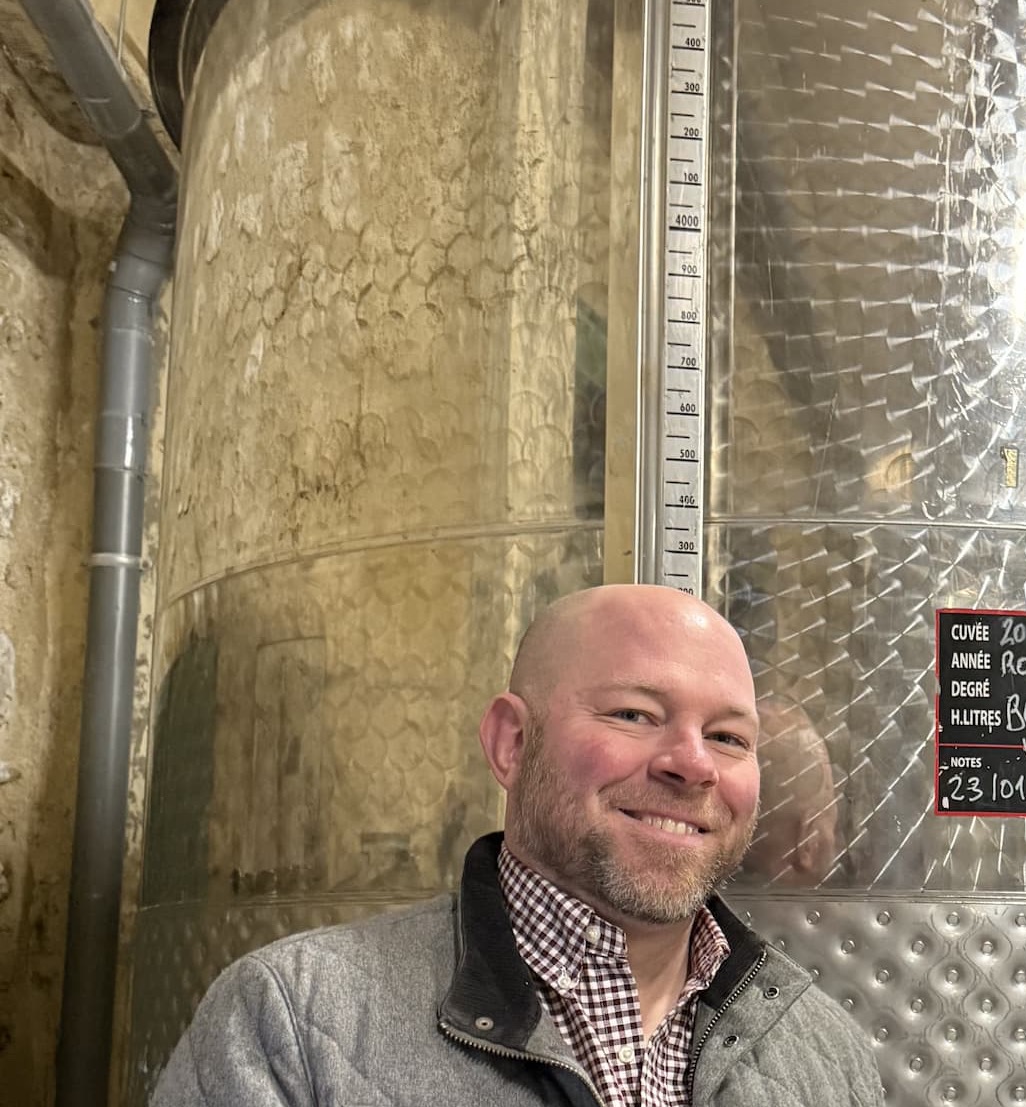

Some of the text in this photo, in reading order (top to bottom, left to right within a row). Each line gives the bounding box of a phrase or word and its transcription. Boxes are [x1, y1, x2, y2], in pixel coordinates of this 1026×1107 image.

[685, 38, 701, 47] 400
[684, 82, 700, 92] 300
[683, 127, 699, 137] 200
[683, 172, 699, 182] 100
[675, 215, 699, 227] 4000
[681, 264, 697, 274] 900
[680, 310, 697, 321] 800
[680, 357, 696, 367] 700
[680, 403, 696, 413] 600
[679, 449, 695, 459] 500
[679, 495, 695, 505] 400
[678, 541, 694, 551] 300
[951, 622, 990, 641] CUVÉE
[951, 651, 991, 670] ANNÉE
[951, 678, 990, 698] DEGRÉ
[951, 709, 1001, 726] H.LITRES
[950, 756, 982, 768] NOTES
